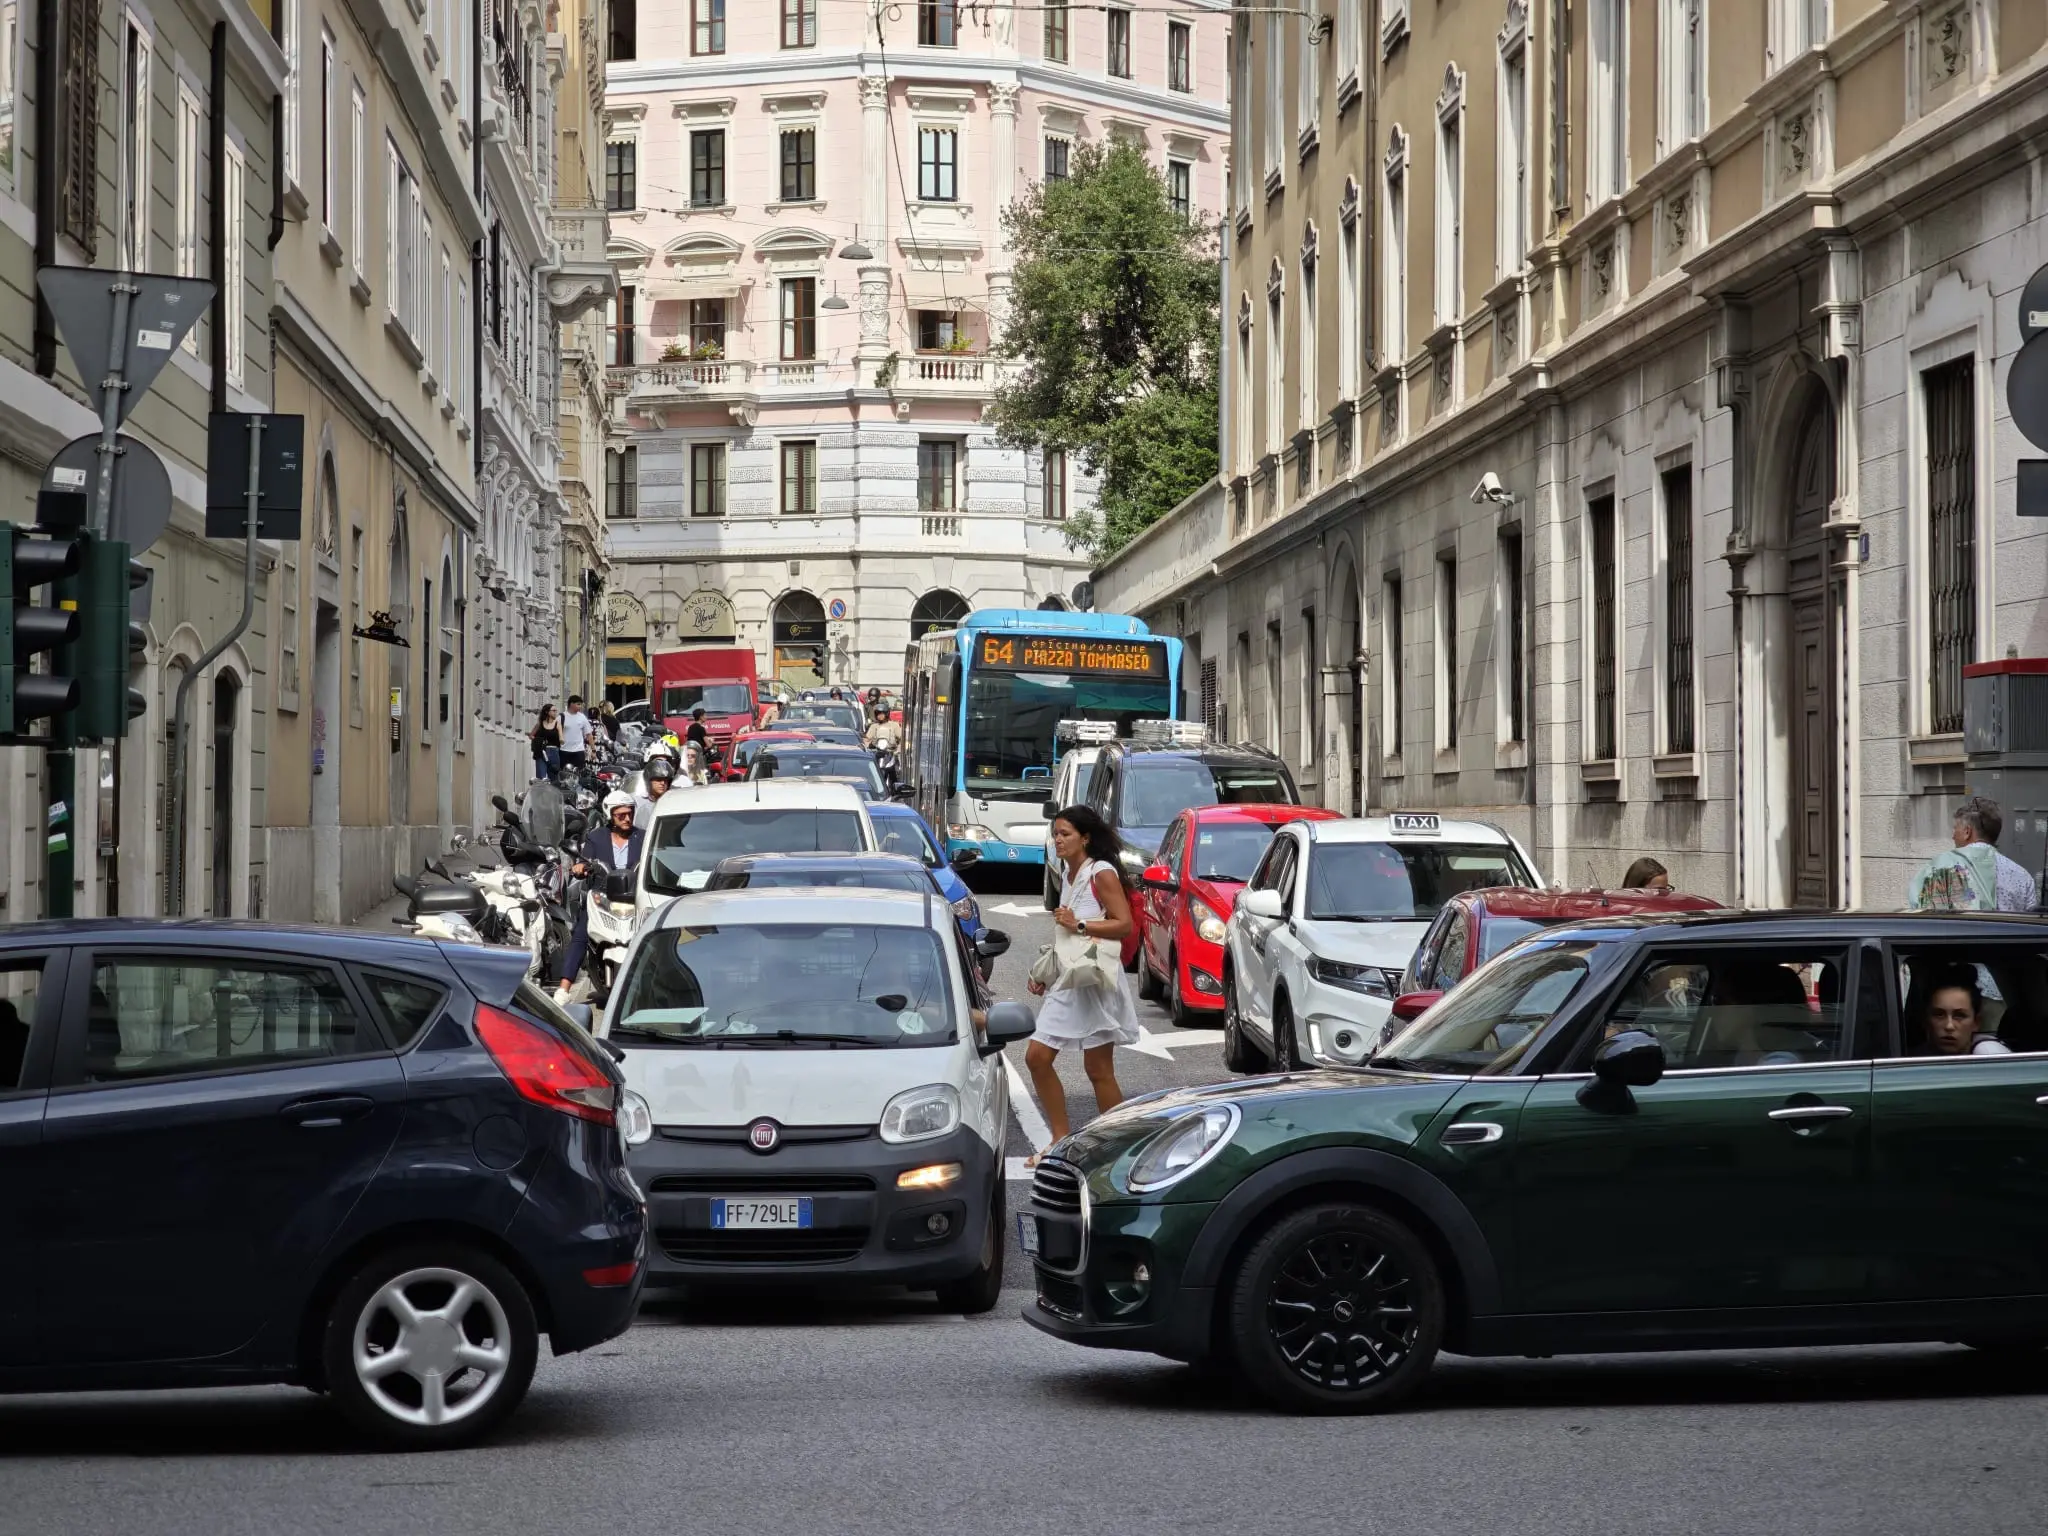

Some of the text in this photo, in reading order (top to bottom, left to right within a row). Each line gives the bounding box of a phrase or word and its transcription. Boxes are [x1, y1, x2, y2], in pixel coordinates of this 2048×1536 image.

[684, 596, 729, 613] PANETTERIA
[984, 638, 1015, 665] 64
[1024, 649, 1150, 670] PIAZZA TOMMASEO
[1396, 816, 1435, 828] TAXI
[756, 1130, 772, 1143] FIAT
